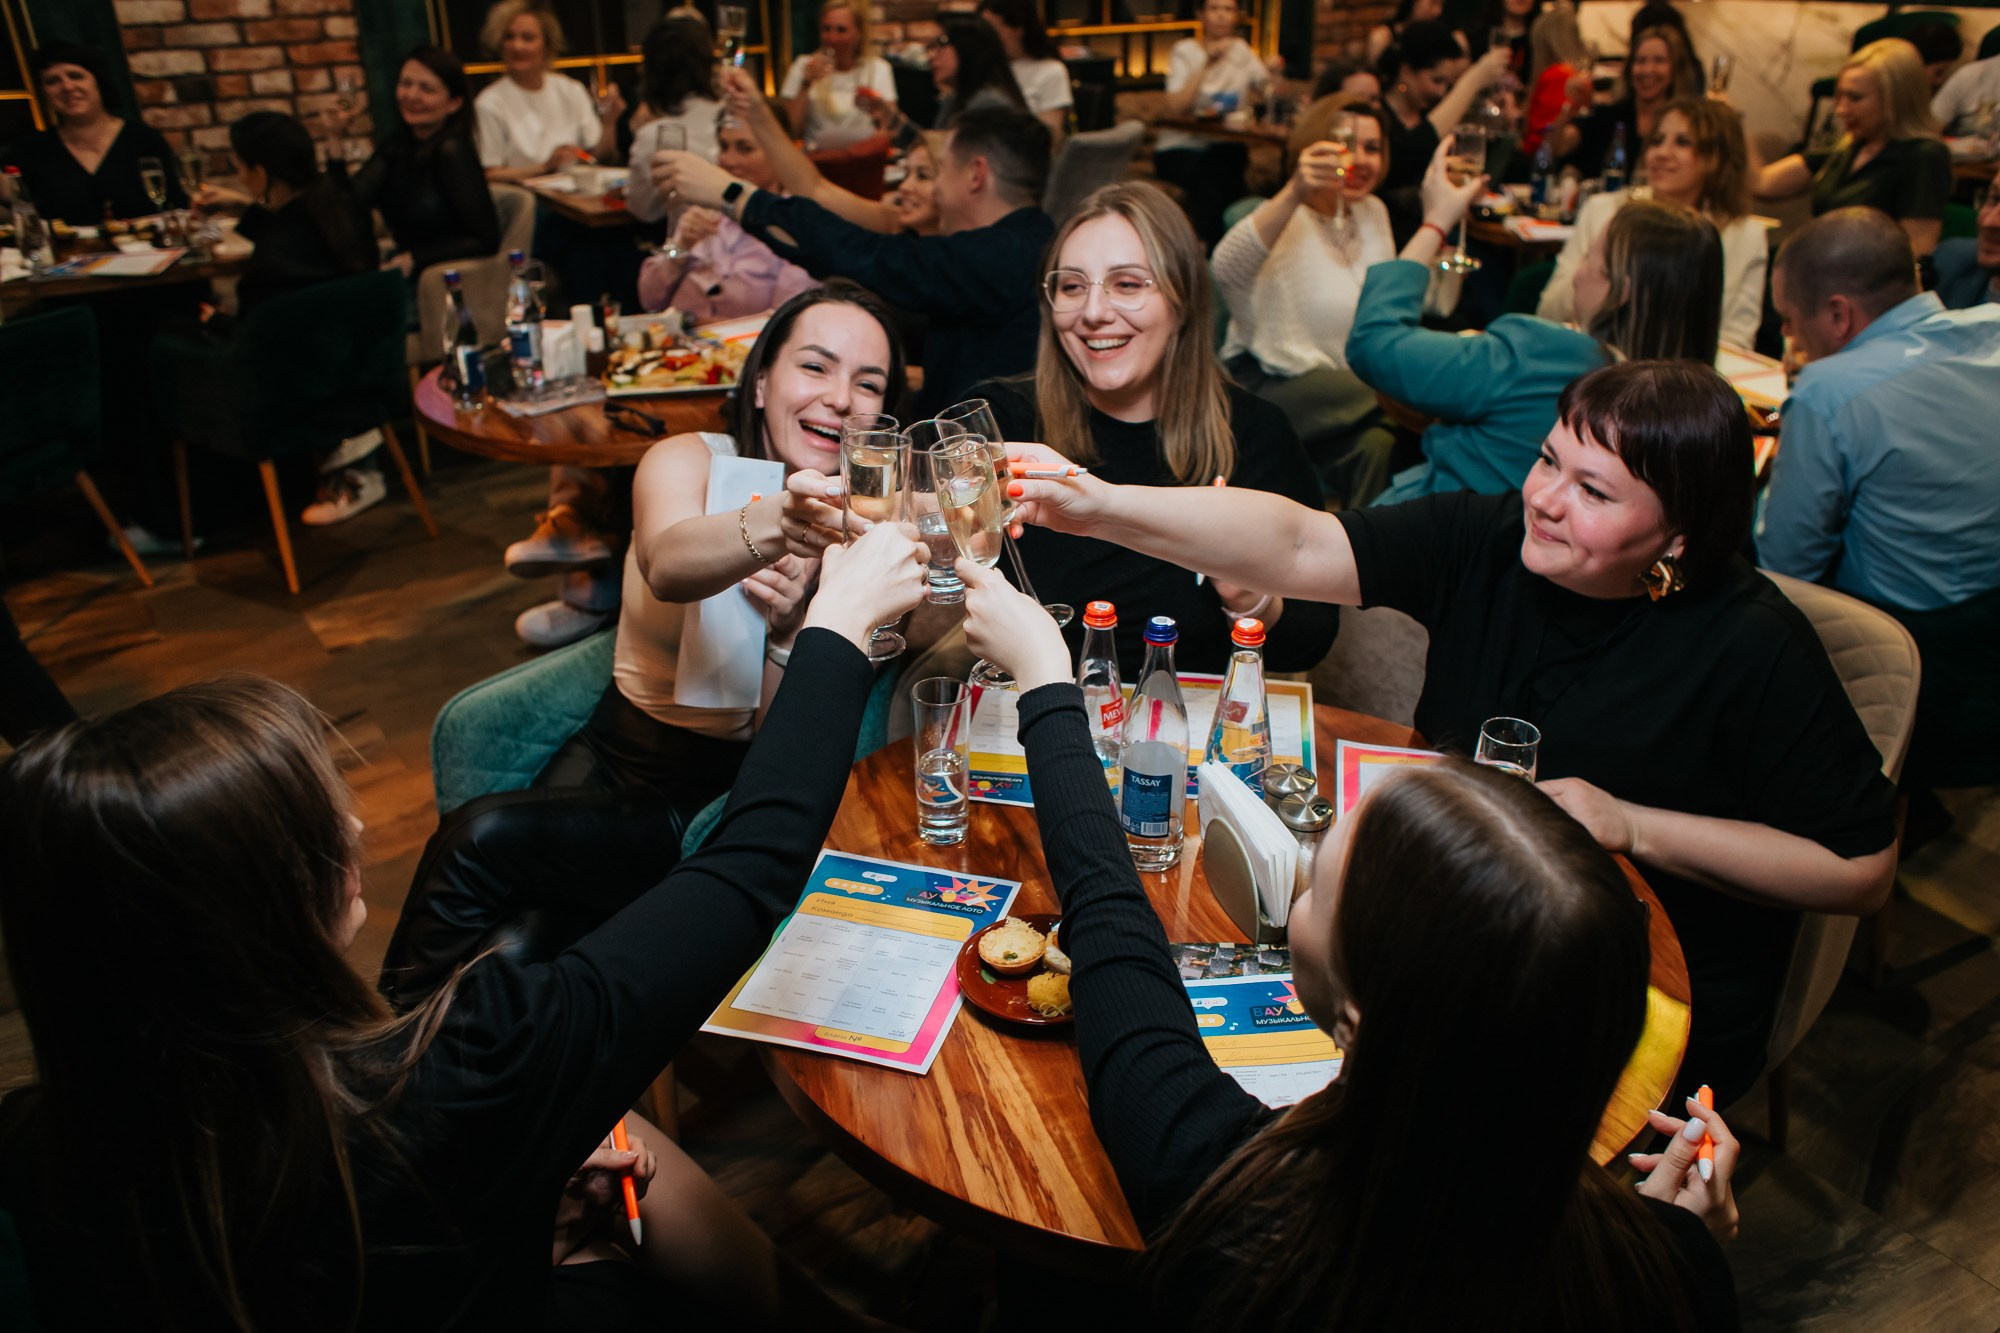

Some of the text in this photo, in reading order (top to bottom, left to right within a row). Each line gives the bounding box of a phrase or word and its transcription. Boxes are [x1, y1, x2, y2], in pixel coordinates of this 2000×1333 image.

[1130, 774, 1162, 787] TASSAY
[811, 905, 854, 918] Команда
[905, 897, 984, 914] МУЗЫКАЛЬНОЕ ЛОТО
[1253, 1006, 1284, 1017] ВАУ
